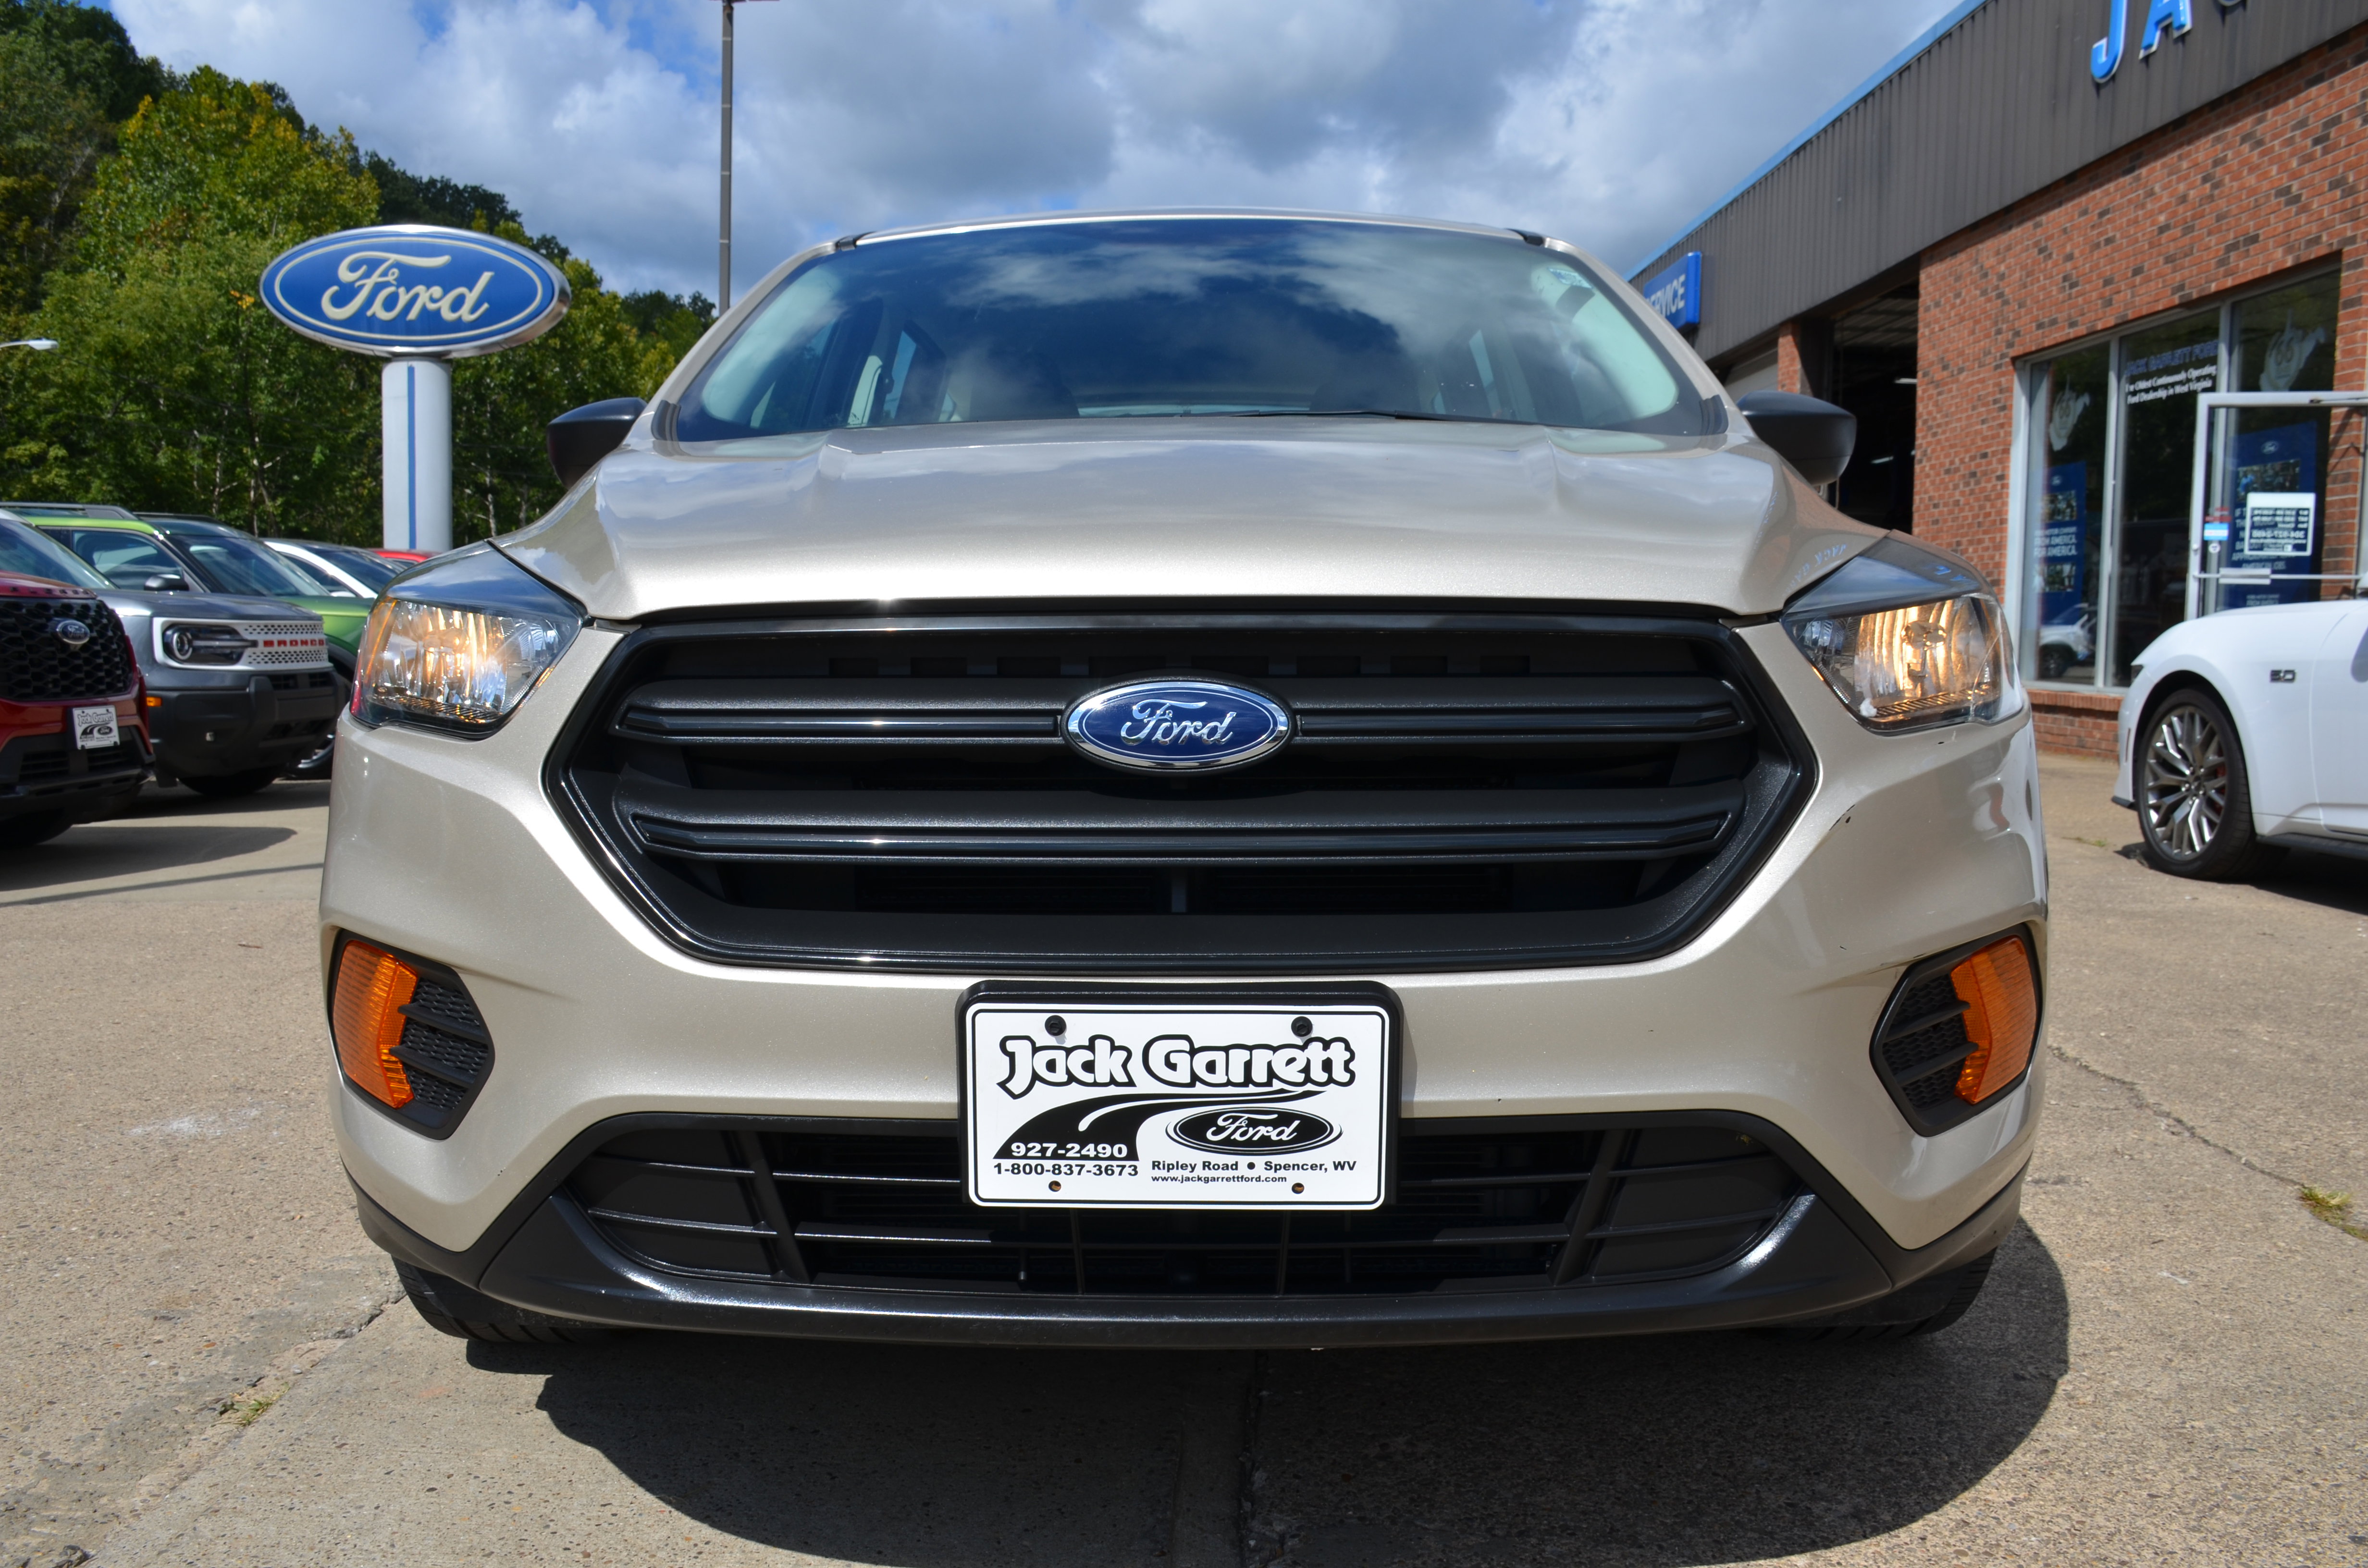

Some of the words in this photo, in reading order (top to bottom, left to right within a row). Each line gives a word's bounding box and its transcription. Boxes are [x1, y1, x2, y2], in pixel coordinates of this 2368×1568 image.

[321, 251, 494, 322] Ford
[263, 639, 325, 648] BRONCO
[1120, 699, 1237, 745] Ford
[996, 1034, 1137, 1100] Jack
[1142, 1034, 1356, 1088] Garrett
[1206, 1113, 1297, 1141] Ford
[1011, 1142, 1128, 1158] 927-2490
[993, 1162, 1139, 1176] 1-800-837-3673
[1151, 1160, 1197, 1172] Ripley
[1202, 1160, 1239, 1171] Road
[1263, 1160, 1328, 1173] Spencer,
[1332, 1160, 1357, 1171] WV
[1151, 1175, 1287, 1184] www.jackgarrettford.com
